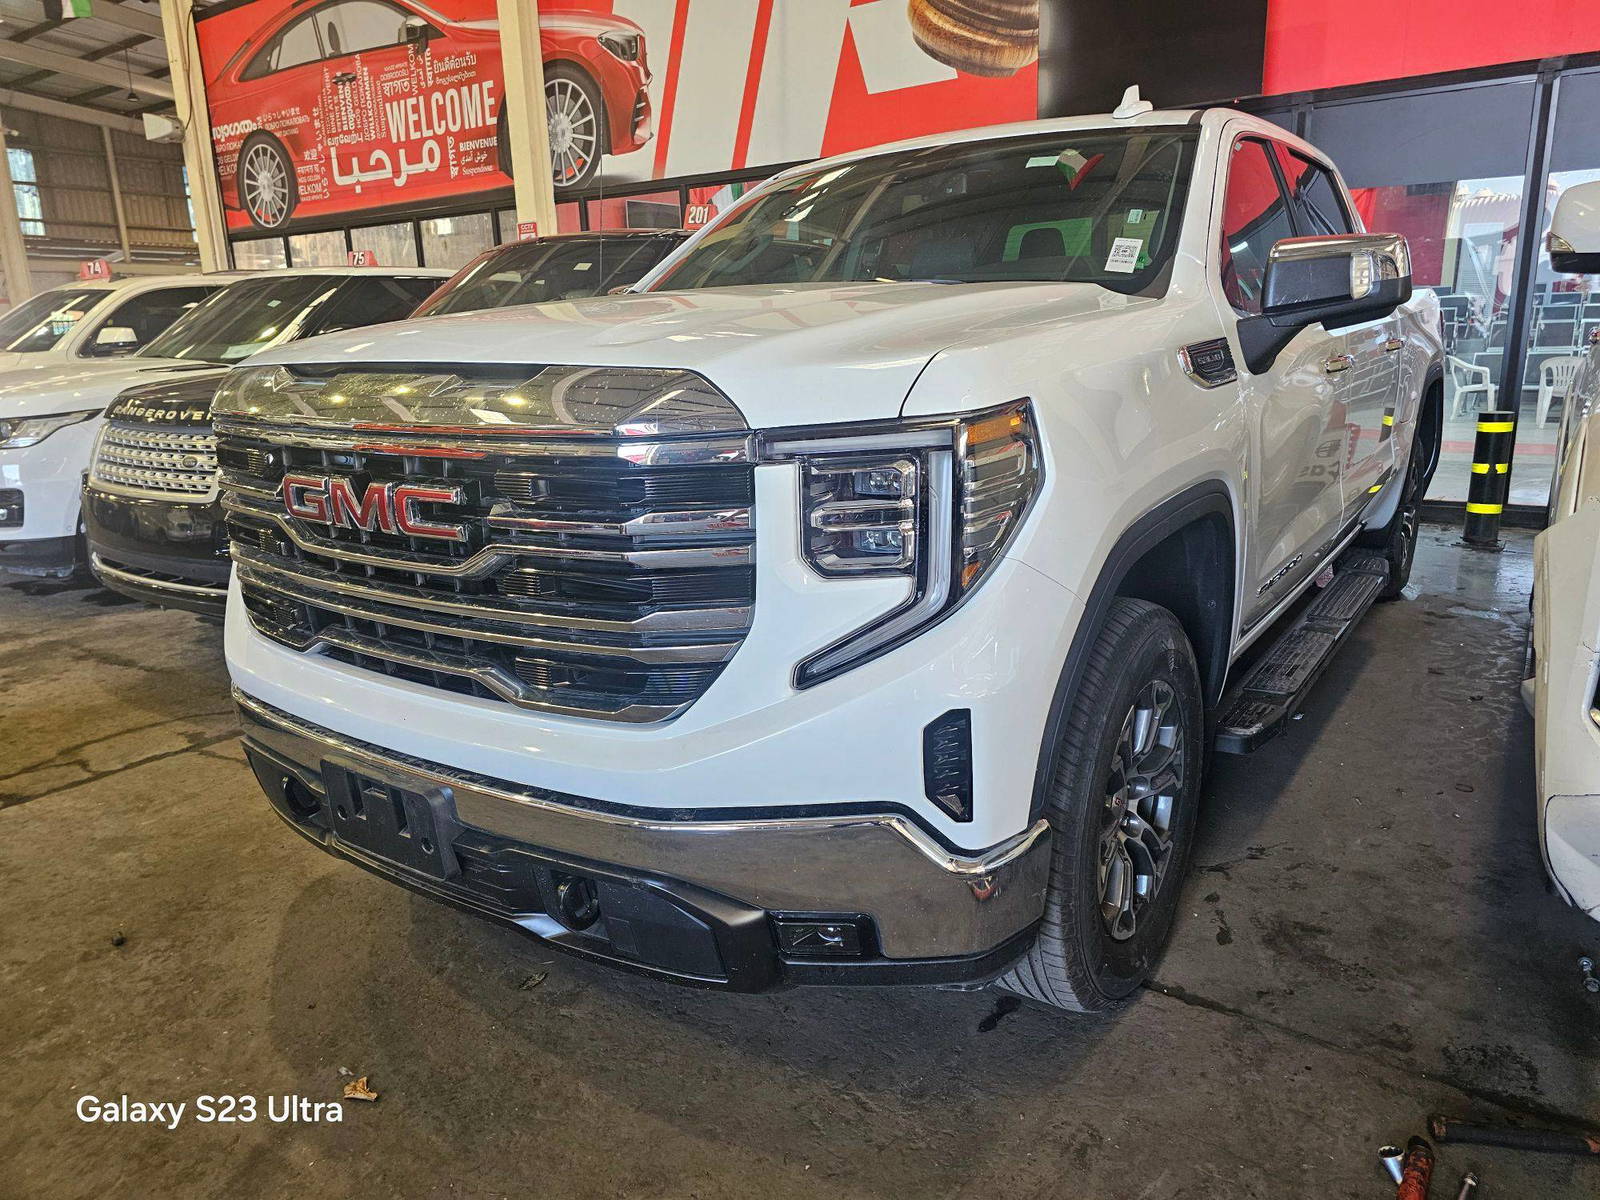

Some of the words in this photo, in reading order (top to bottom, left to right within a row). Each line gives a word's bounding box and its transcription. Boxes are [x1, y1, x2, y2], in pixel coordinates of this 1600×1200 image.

[384, 79, 499, 144] WELCOME
[459, 137, 498, 152] BIENVENUE
[330, 139, 442, 194] مرحبا
[688, 205, 709, 225] 201
[87, 262, 102, 275] 74
[352, 252, 365, 266] 75
[282, 473, 468, 542] GMC
